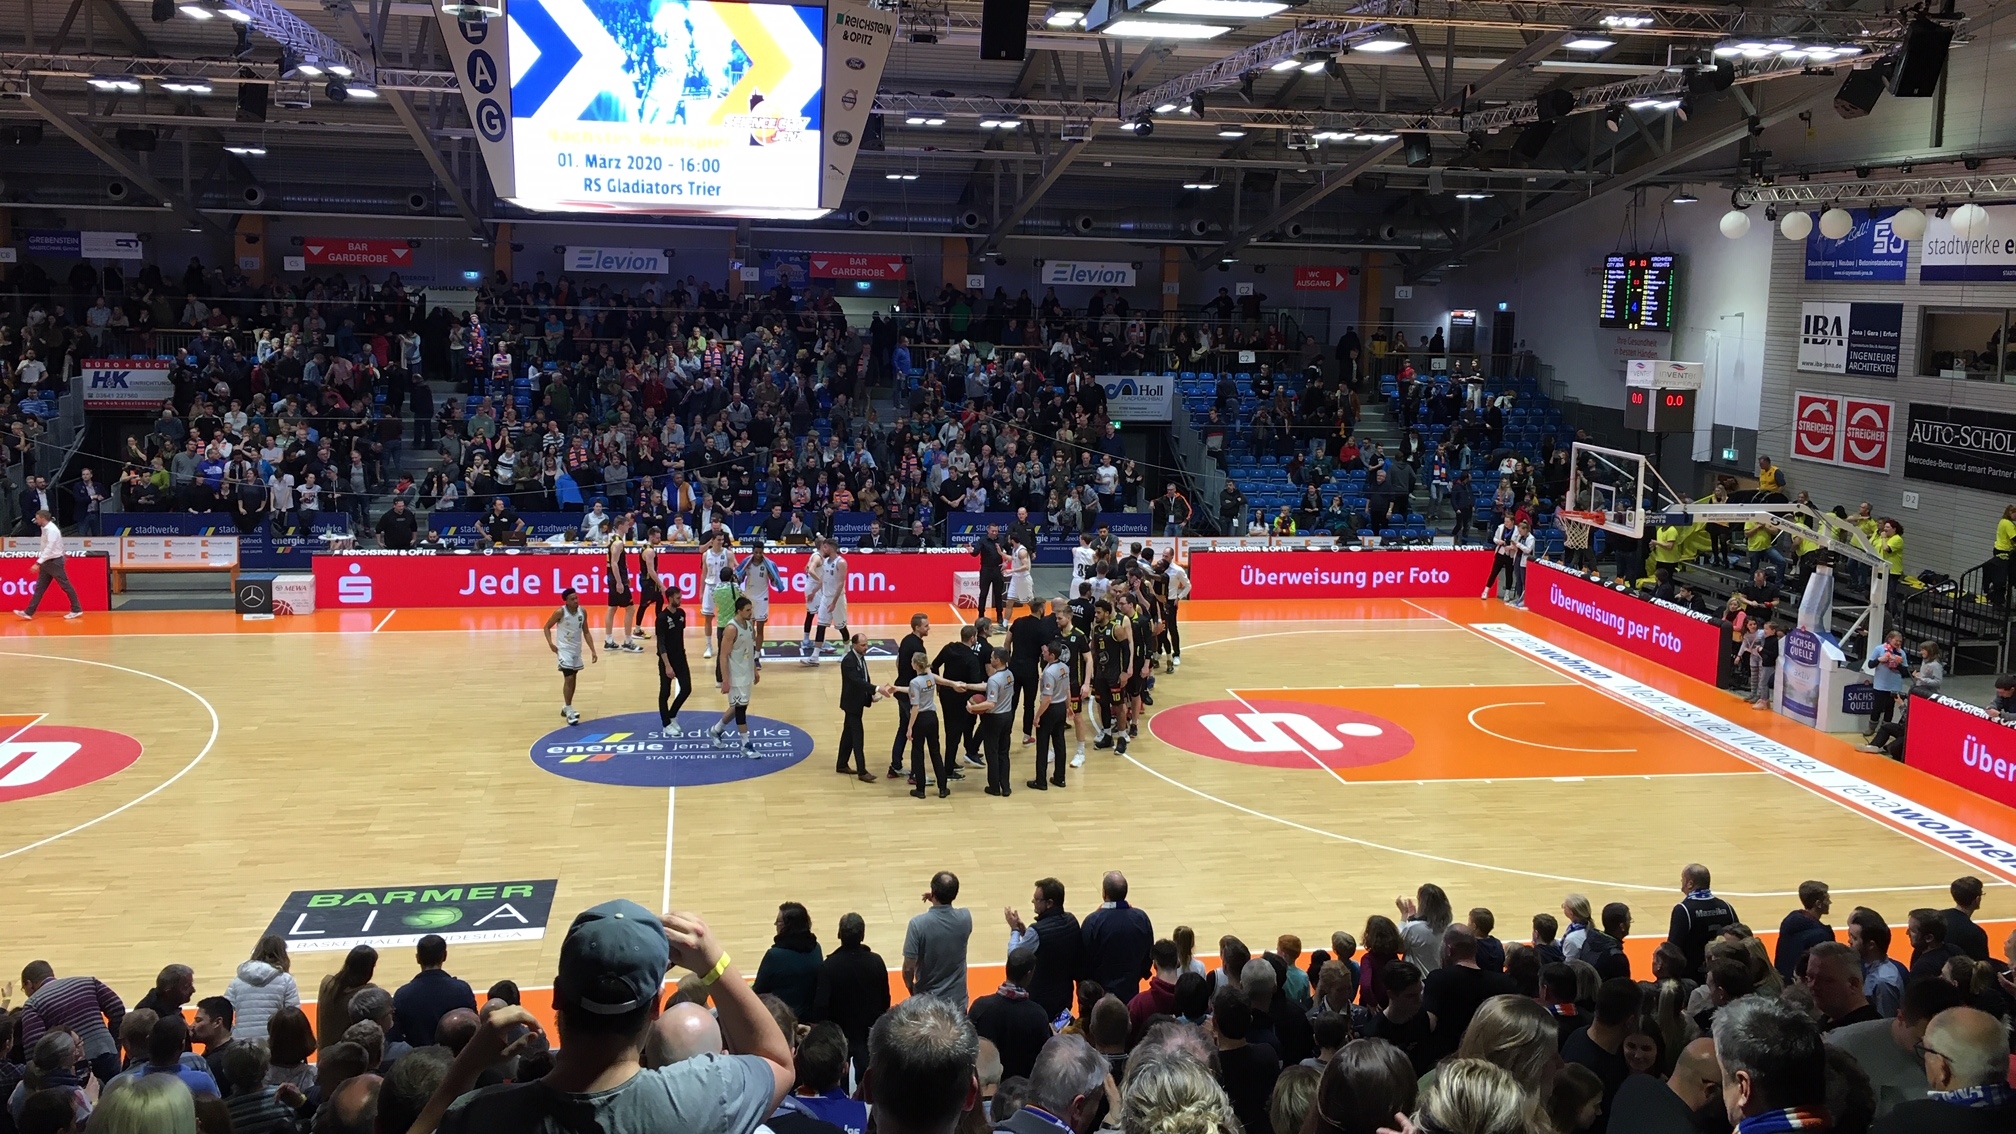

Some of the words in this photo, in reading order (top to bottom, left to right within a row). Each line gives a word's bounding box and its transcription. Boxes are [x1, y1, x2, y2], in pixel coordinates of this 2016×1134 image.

[849, 31, 873, 46] OPITZ
[557, 152, 579, 167] 01.
[584, 153, 622, 169] März
[627, 155, 663, 172] 2020
[680, 157, 721, 173] 16:00
[583, 177, 601, 191] RS
[607, 178, 683, 195] Gladiators
[687, 181, 722, 197] Trier
[28, 236, 79, 245] GREBENSTEIN
[348, 242, 368, 251] BAR
[1927, 233, 2000, 256] stadtwerke
[327, 252, 389, 264] GARDEROBE
[576, 249, 658, 271] Elevion
[849, 257, 868, 266] BAR
[830, 267, 885, 278] GARDEROBE
[1051, 263, 1127, 284] Elevion
[1308, 270, 1320, 278] WC
[969, 278, 982, 287] C3
[1296, 279, 1331, 288] AUSGANG
[1239, 286, 1250, 295] C2
[1398, 289, 1409, 298] C1
[1631, 302, 1638, 312] 4
[1803, 314, 1844, 347] IBA
[1882, 330, 1898, 338] Erfurt
[1239, 353, 1250, 362] C2
[1849, 350, 1897, 363] INGENIEURE
[85, 360, 119, 368] BÜRO
[135, 360, 170, 368] KÜCH
[1431, 361, 1442, 369] C1
[1848, 361, 1896, 374] ARCHITEKTEN
[1139, 384, 1164, 396] Holl
[1631, 392, 1643, 404] 0.0
[1666, 394, 1684, 406] 0.0
[1798, 419, 1835, 436] STREICHER
[1847, 426, 1886, 442] STREICHER
[1909, 422, 2016, 454] AUTO-SCHOL
[1907, 454, 1954, 470] Mercedes-Benz
[1953, 463, 1967, 472] und
[1967, 464, 1987, 475] smart
[1987, 466, 2013, 479] Partner
[134, 525, 180, 534] stadtwerke
[1111, 524, 1148, 533] stadtwerke
[271, 536, 306, 547] energie
[951, 534, 981, 545] energie
[342, 549, 399, 557] REICHSTEIN
[408, 549, 437, 557] OPITZ
[771, 547, 797, 555] OPITZ
[459, 566, 542, 596] Jede
[1239, 564, 1367, 589] Überweisung
[1372, 569, 1405, 588] per
[1409, 566, 1450, 585] Foto
[284, 585, 308, 593] MEWA
[1550, 583, 1625, 637] Überweisung
[1627, 620, 1650, 641] per
[1652, 624, 1682, 653] Foto
[1692, 611, 1713, 624] OPITZ
[1789, 635, 1817, 652] SACHSEN
[1502, 636, 1613, 680] jenawohnen
[1789, 645, 1814, 661] QUELLE
[1614, 684, 1675, 706] Mehr
[1847, 692, 1875, 701] SACHS
[1849, 701, 1874, 711] QUELL
[1662, 706, 1703, 719] als
[1692, 718, 1741, 736] vier
[546, 740, 664, 754] energie
[1730, 735, 1836, 774] Wände!
[1962, 733, 2016, 782] Über
[305, 884, 535, 908] BARMER
